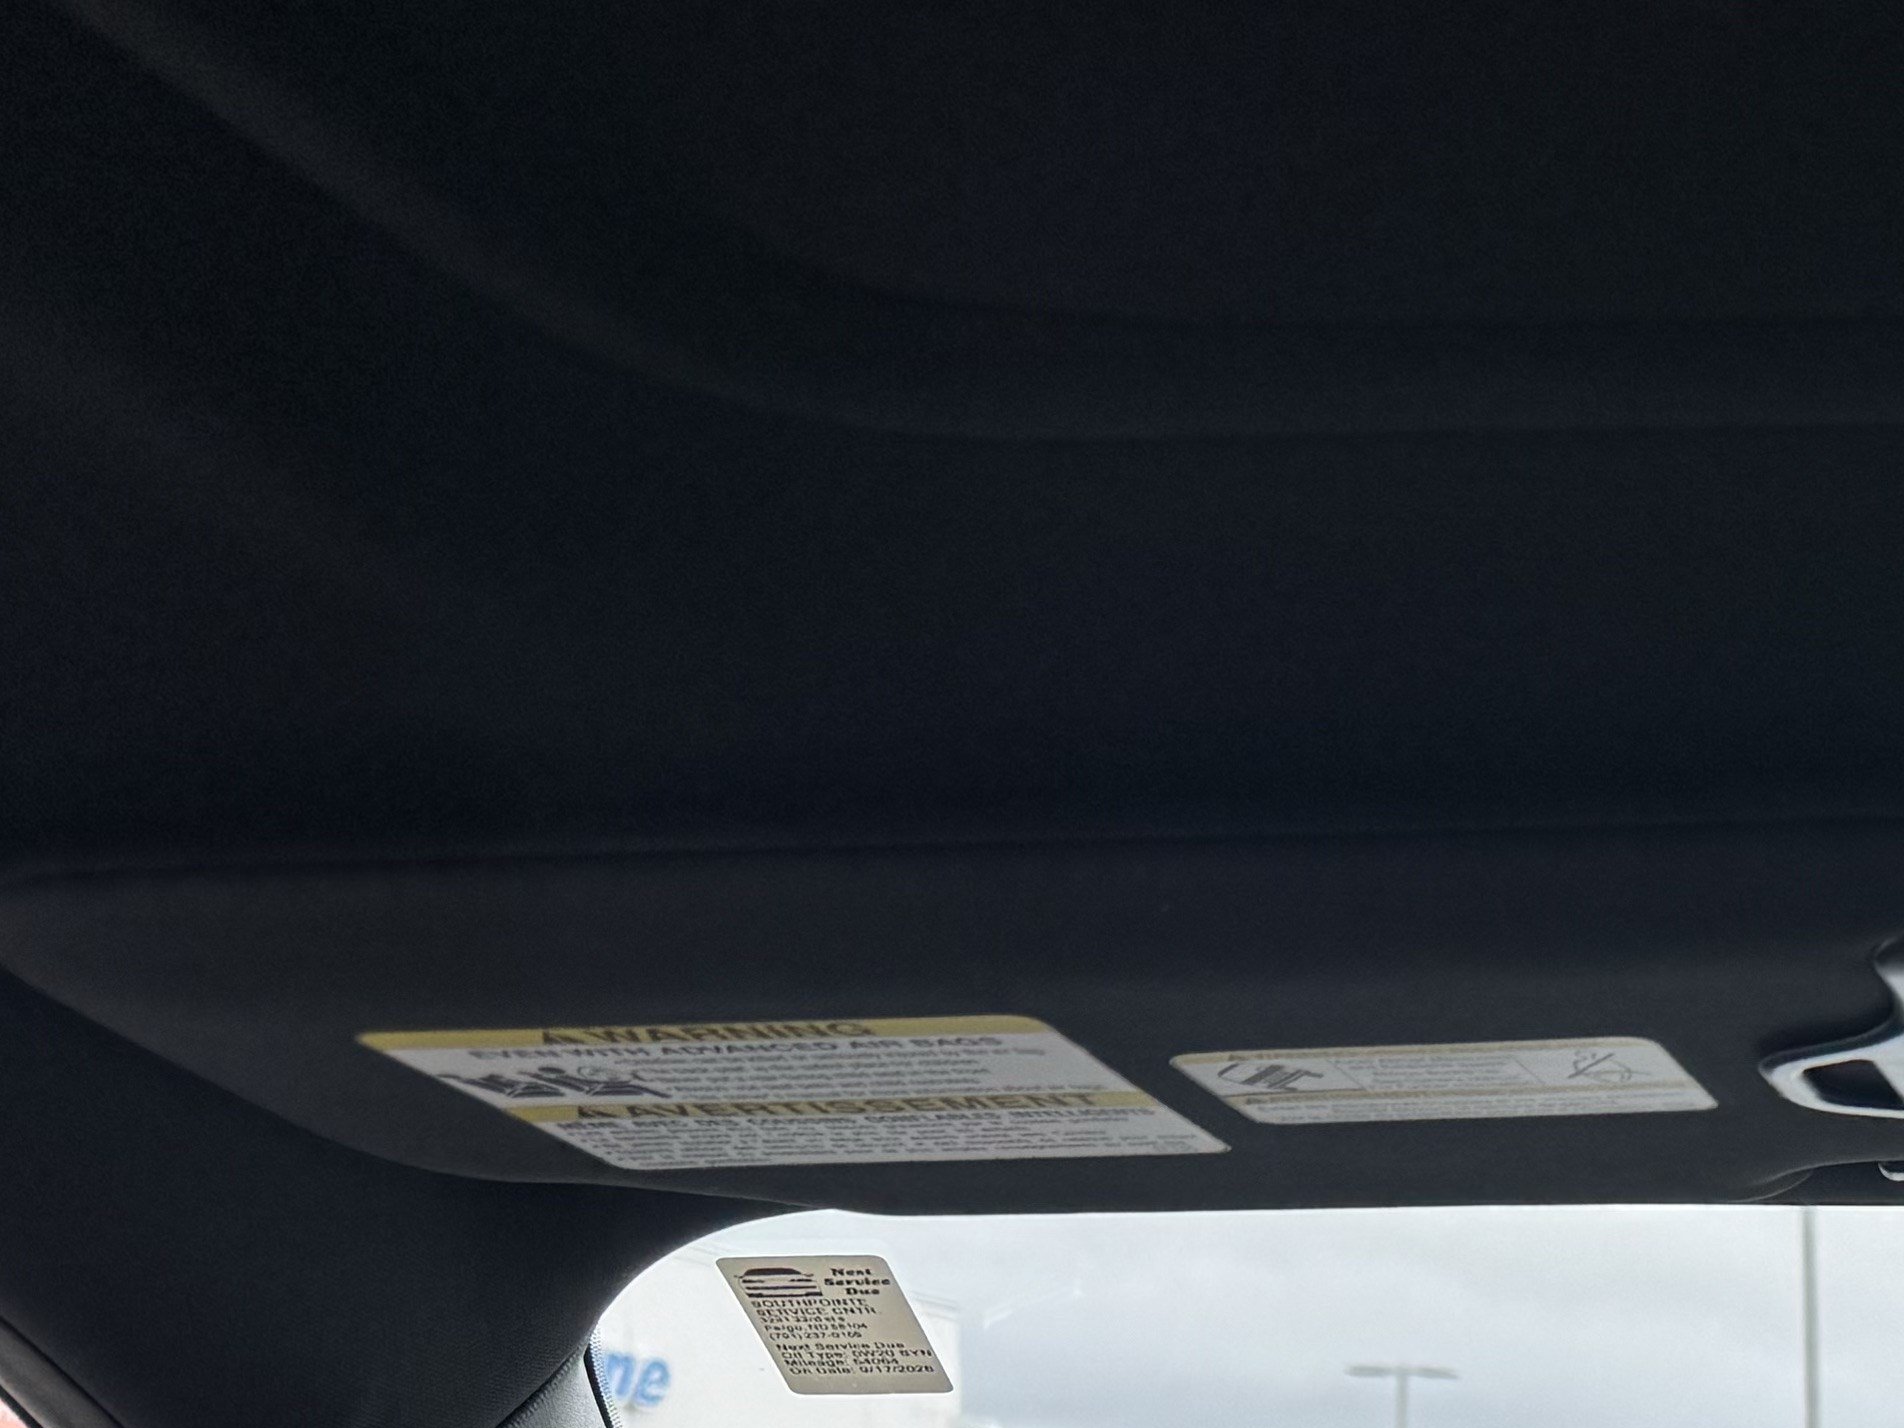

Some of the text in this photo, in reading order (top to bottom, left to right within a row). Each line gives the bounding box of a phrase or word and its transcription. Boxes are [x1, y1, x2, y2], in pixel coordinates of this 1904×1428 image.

[577, 1021, 883, 1043] WARNING
[616, 1091, 1108, 1121] AVERTISSEMENT
[824, 1278, 891, 1286] Service
[845, 1287, 880, 1295] Due
